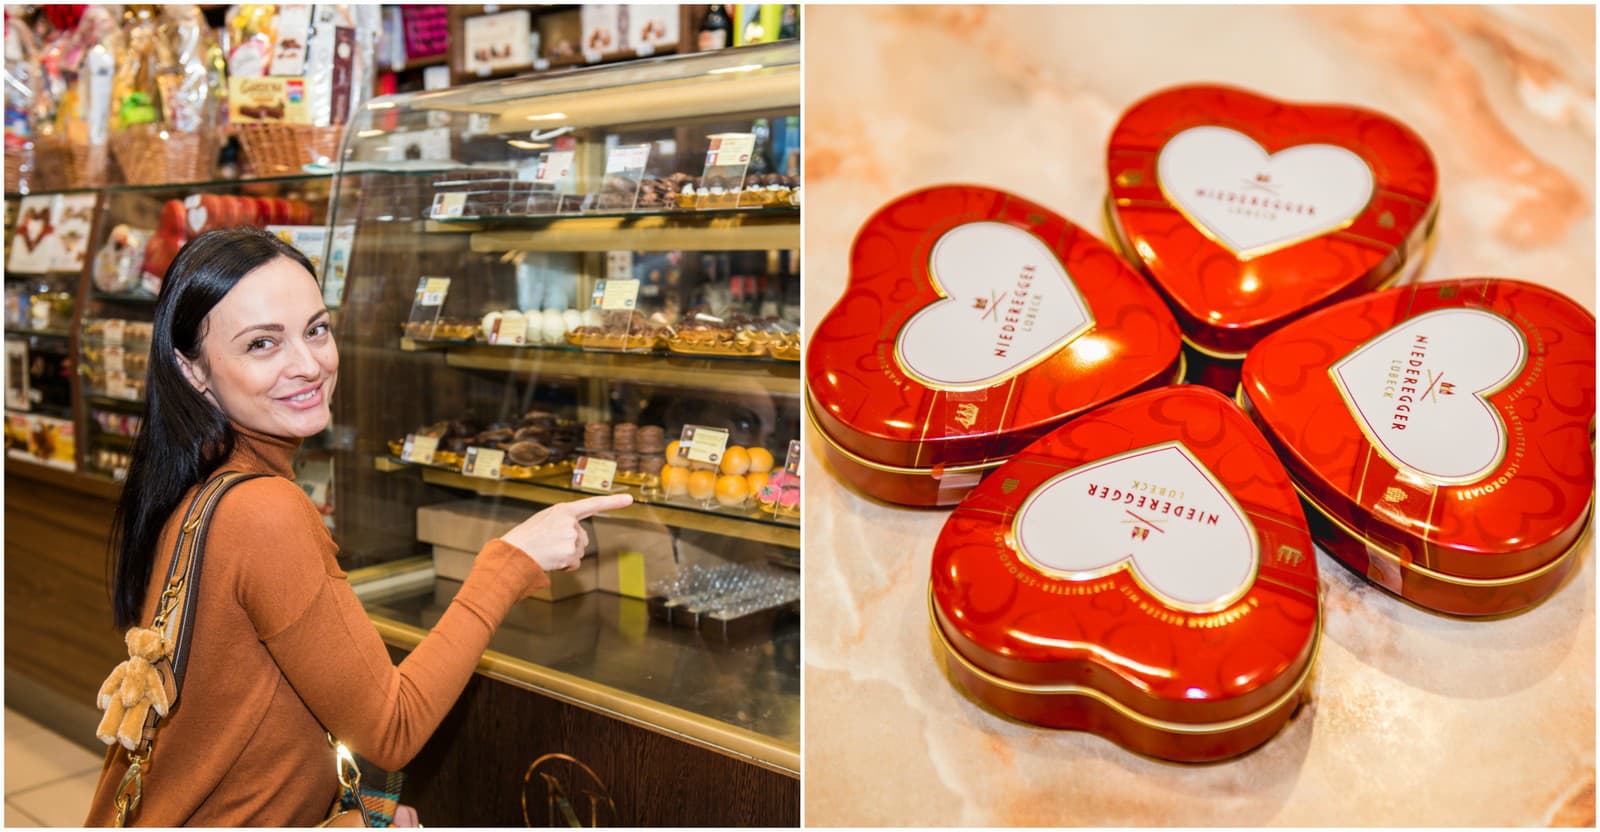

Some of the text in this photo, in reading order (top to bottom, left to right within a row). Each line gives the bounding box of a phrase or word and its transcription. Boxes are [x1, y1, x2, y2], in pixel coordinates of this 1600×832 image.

[993, 264, 1036, 358] NIEDEREGGER
[1391, 334, 1429, 431] NIEDEREGGER
[1087, 482, 1220, 526] NIEDEREGGER
